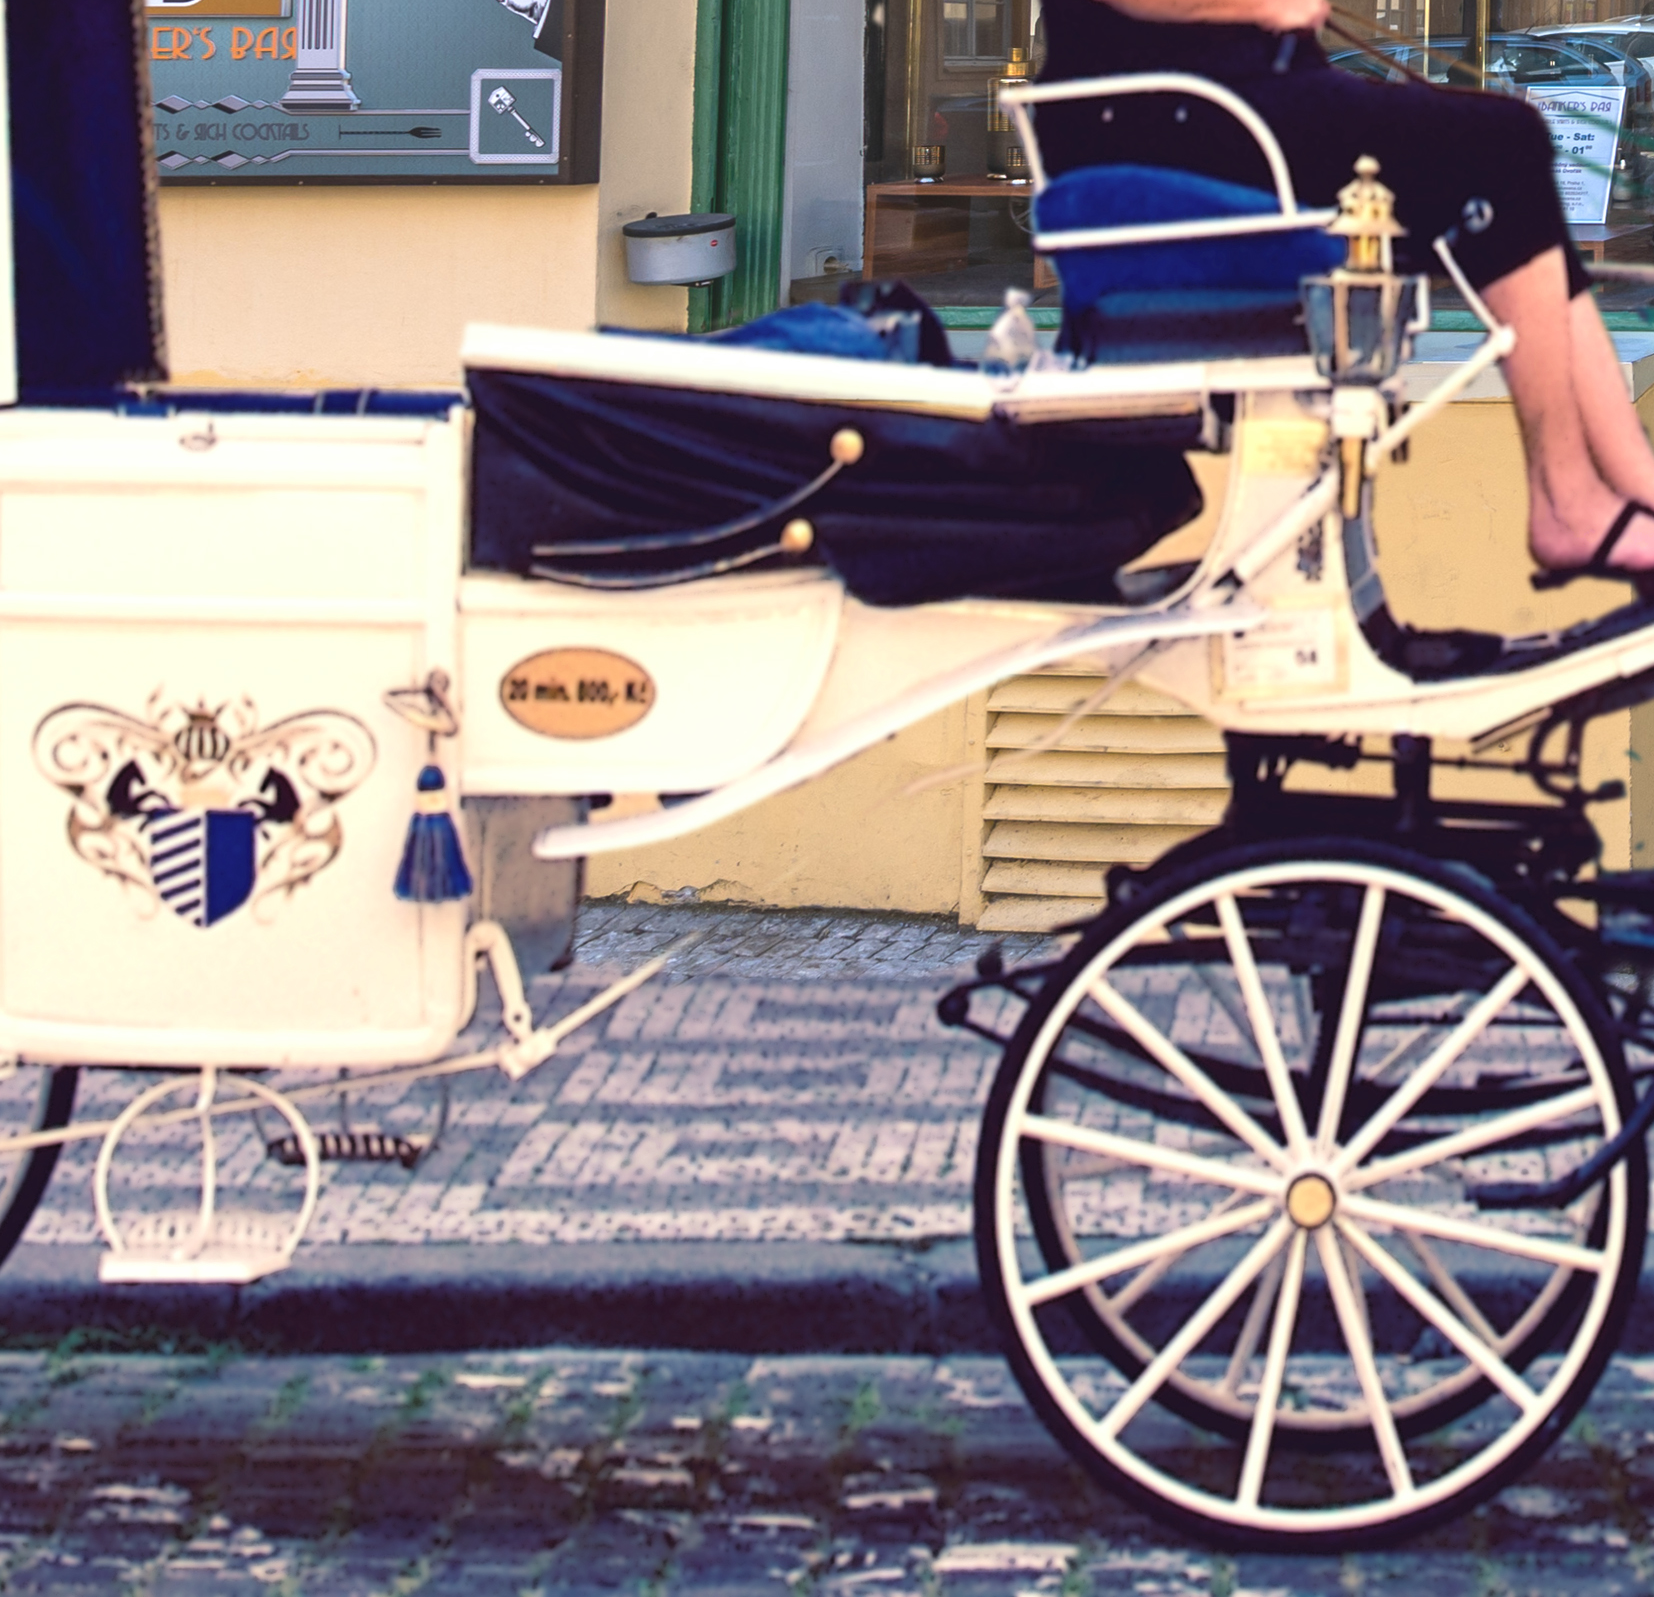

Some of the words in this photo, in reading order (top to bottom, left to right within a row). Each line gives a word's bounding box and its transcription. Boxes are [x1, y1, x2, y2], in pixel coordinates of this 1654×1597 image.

[176, 122, 190, 142] &
[232, 121, 310, 143] COCKTAILS
[1573, 132, 1595, 141] Sat:
[508, 678, 528, 702] 20
[534, 676, 571, 702] min.
